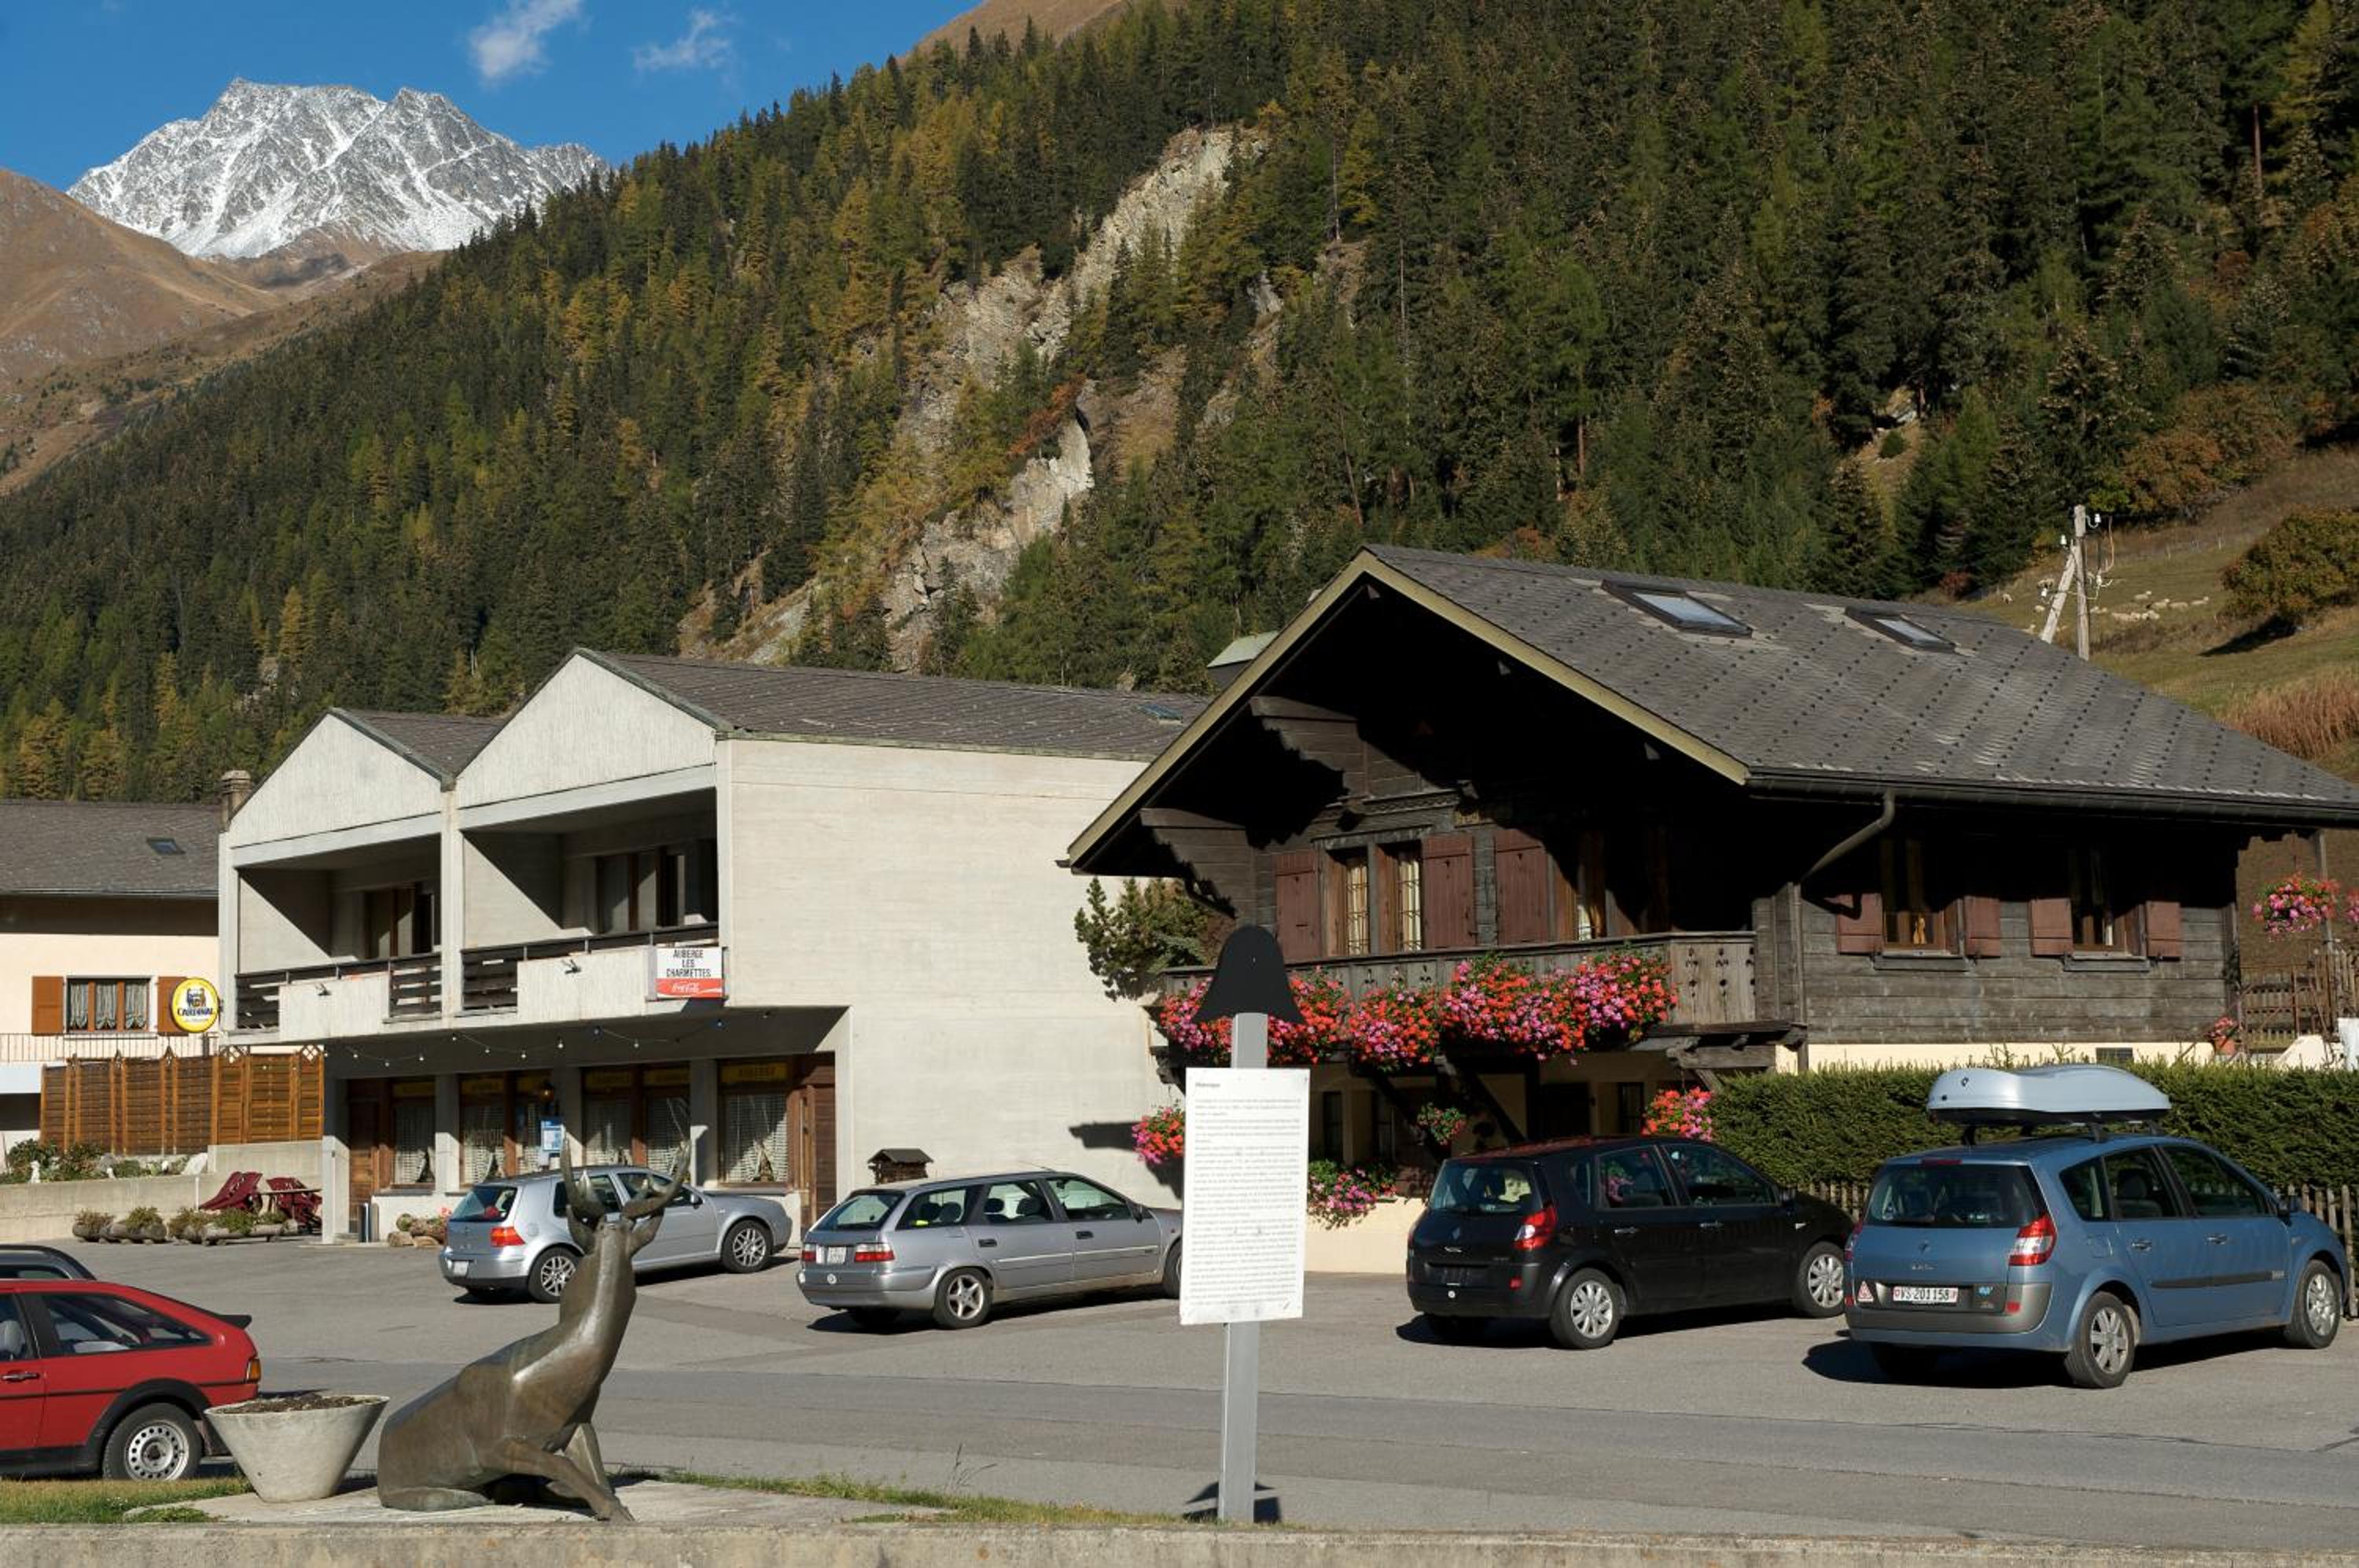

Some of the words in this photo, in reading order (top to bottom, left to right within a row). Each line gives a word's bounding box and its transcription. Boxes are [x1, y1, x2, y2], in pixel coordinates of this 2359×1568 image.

[673, 949, 704, 959] AUBERGE
[682, 959, 695, 968] LES
[666, 968, 712, 977] CHARMETTES
